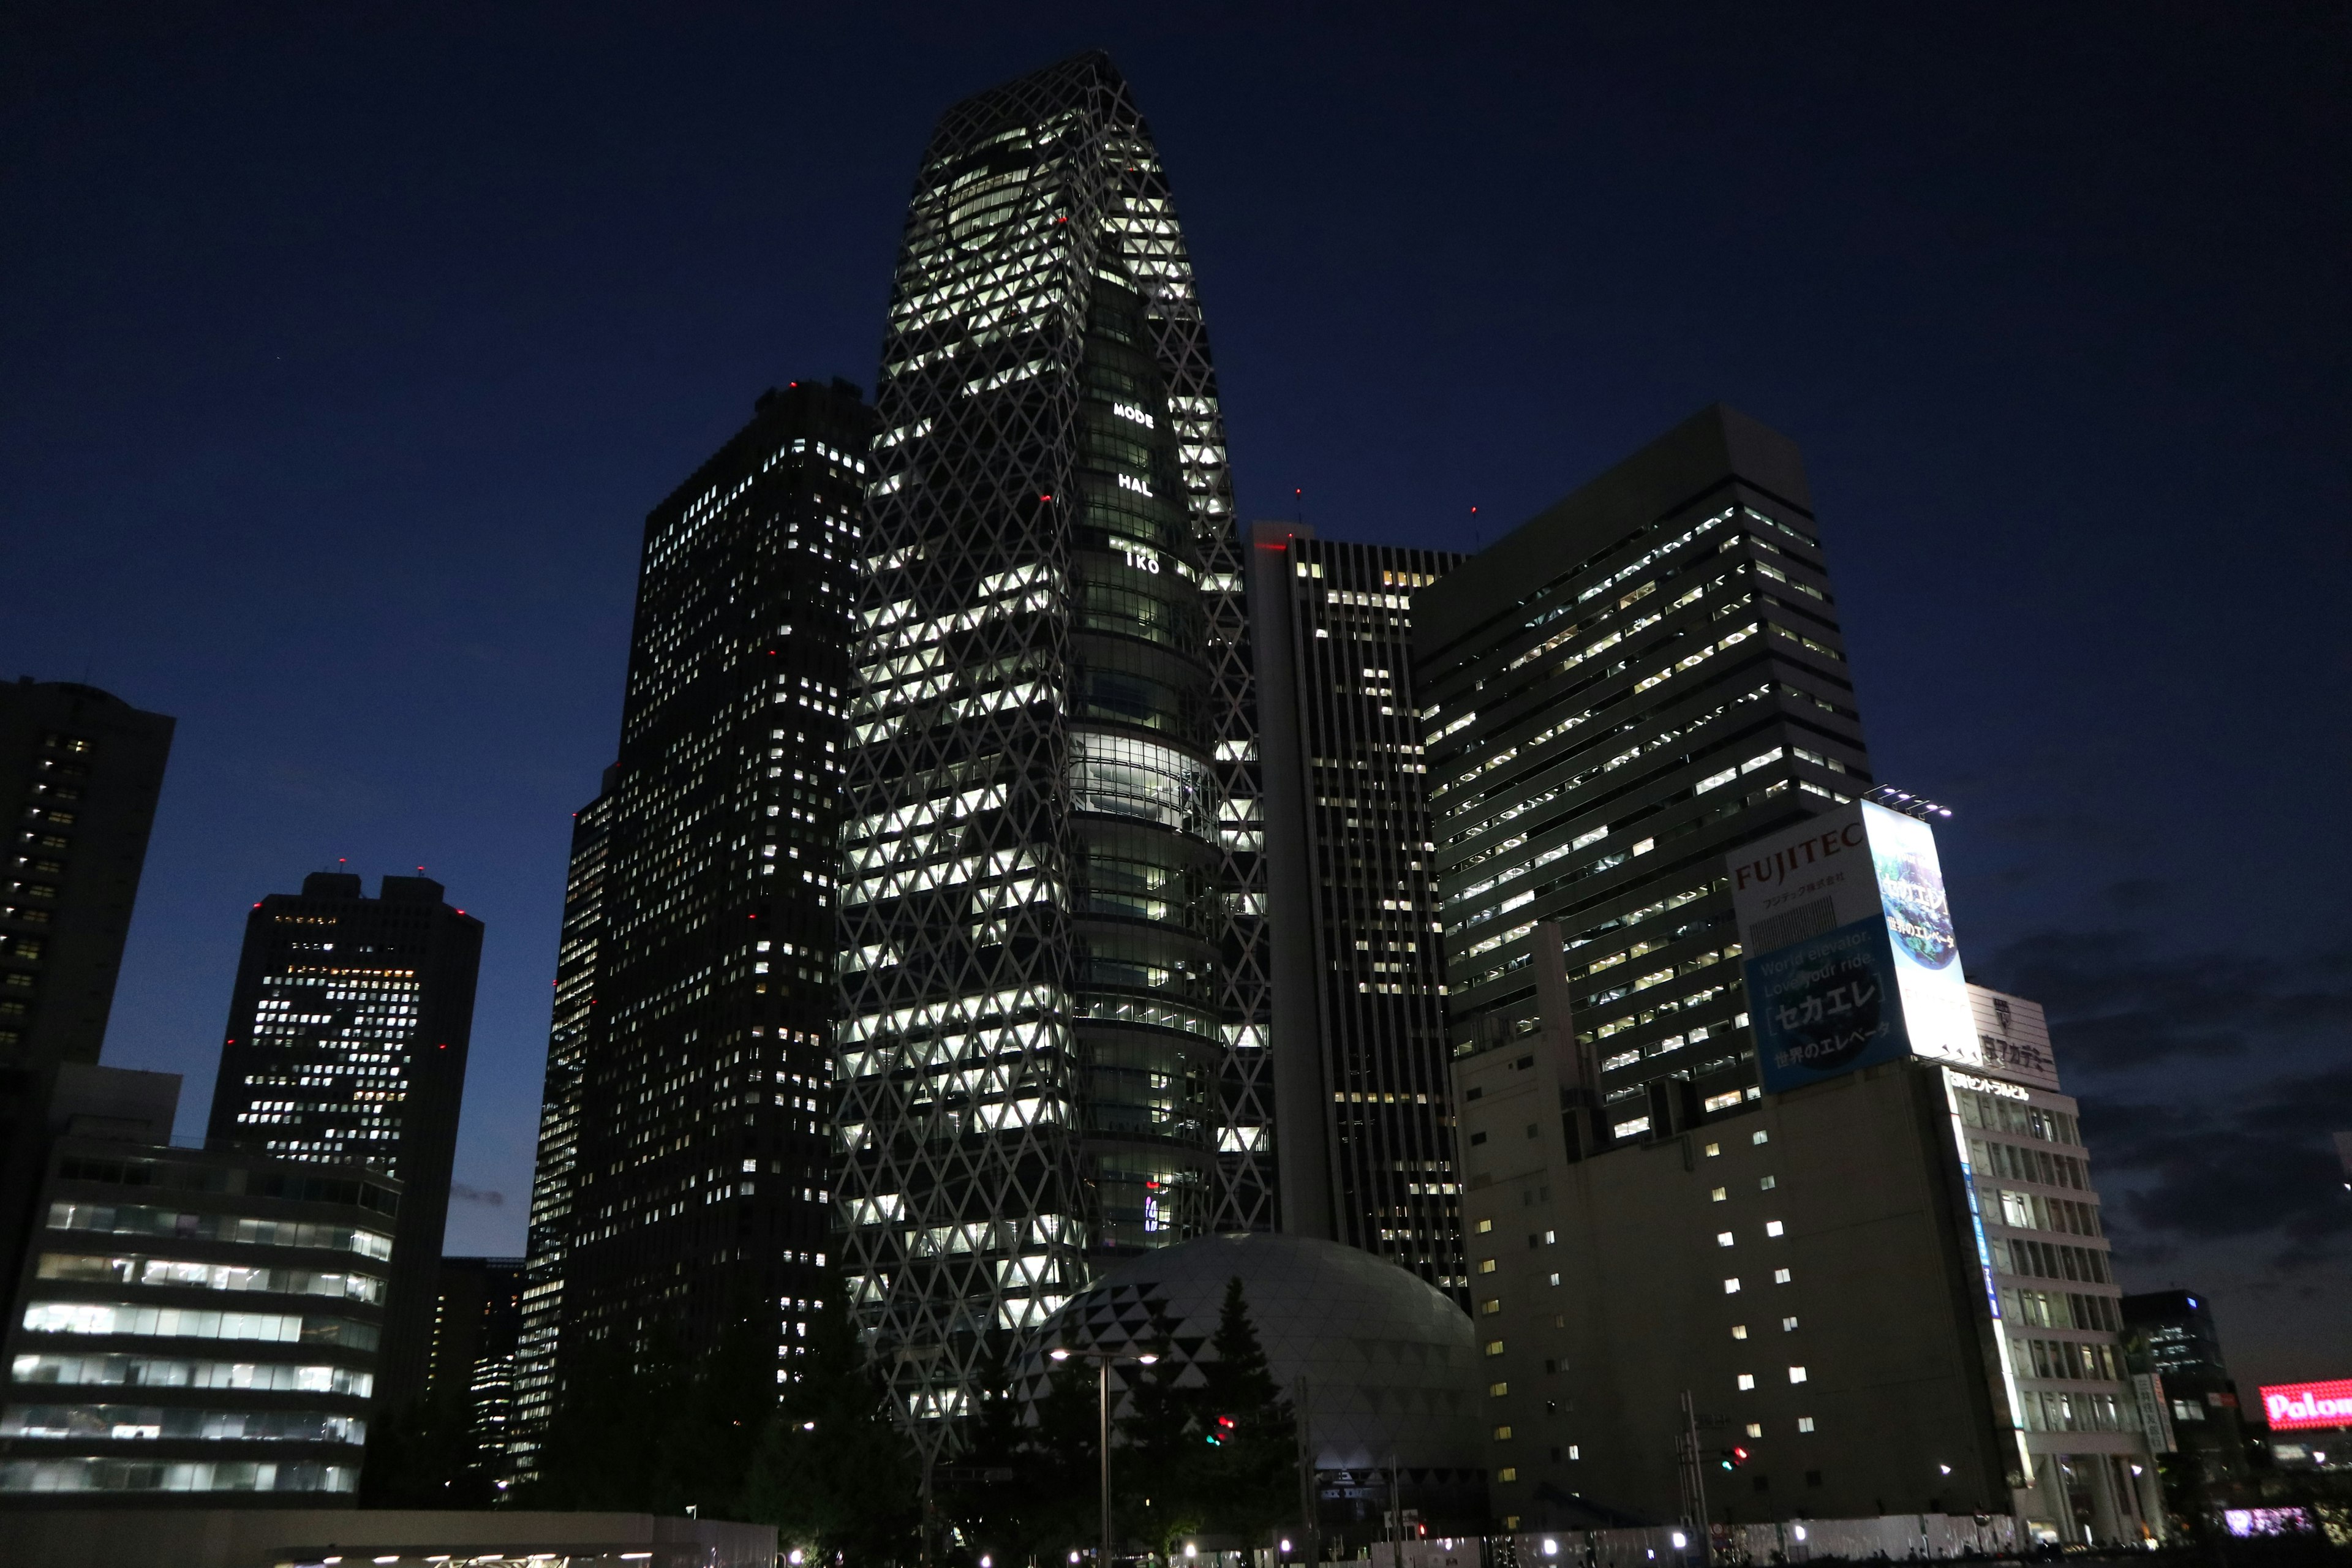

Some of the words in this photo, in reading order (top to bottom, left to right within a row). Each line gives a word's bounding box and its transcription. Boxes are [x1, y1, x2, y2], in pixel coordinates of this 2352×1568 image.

[1114, 402, 1155, 429] MODE
[1118, 473, 1153, 498] HAL
[1735, 822, 1863, 891] FUJITEC
[1763, 872, 1845, 909] フジテック株式会社
[1887, 915, 1954, 949] 世界のエレベータ
[1760, 954, 1804, 977] World
[1808, 930, 1872, 960] elevator.
[1764, 970, 1804, 998] Love
[1803, 963, 1837, 989] your
[1841, 952, 1875, 972] ride.
[1774, 1021, 1890, 1070] 世界のエレベータ
[1978, 1034, 2054, 1072] 京アカデミー
